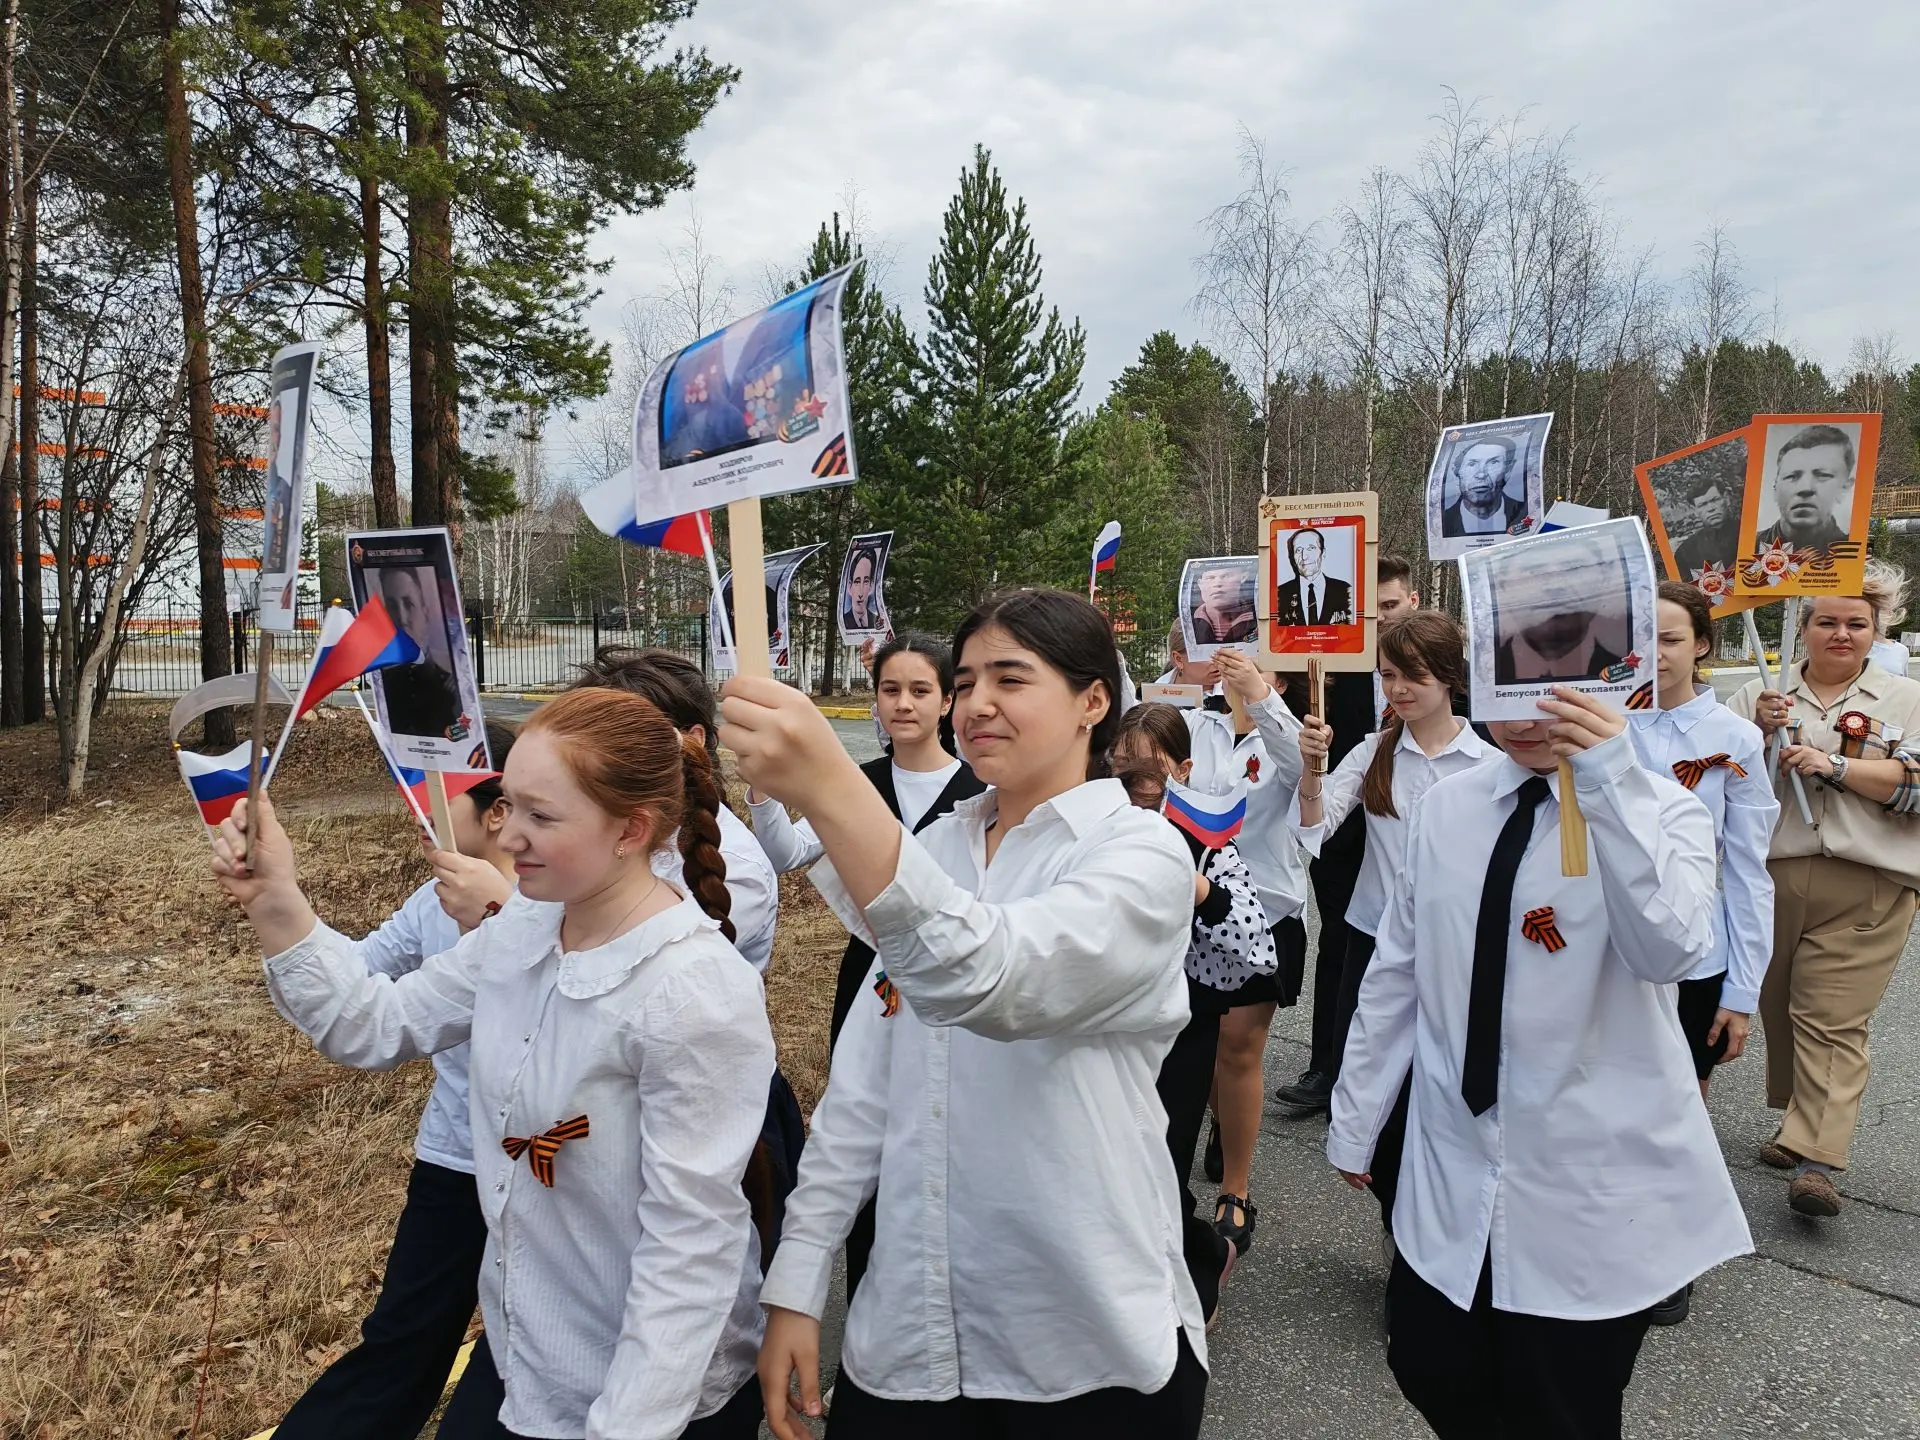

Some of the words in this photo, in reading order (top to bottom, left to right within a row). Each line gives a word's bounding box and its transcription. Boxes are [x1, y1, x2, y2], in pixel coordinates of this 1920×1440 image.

[1285, 501, 1342, 511] БЕССМЕРТНЫЙ
[1343, 500, 1365, 508] ПОЛК
[1495, 690, 1541, 698] Белоусов
